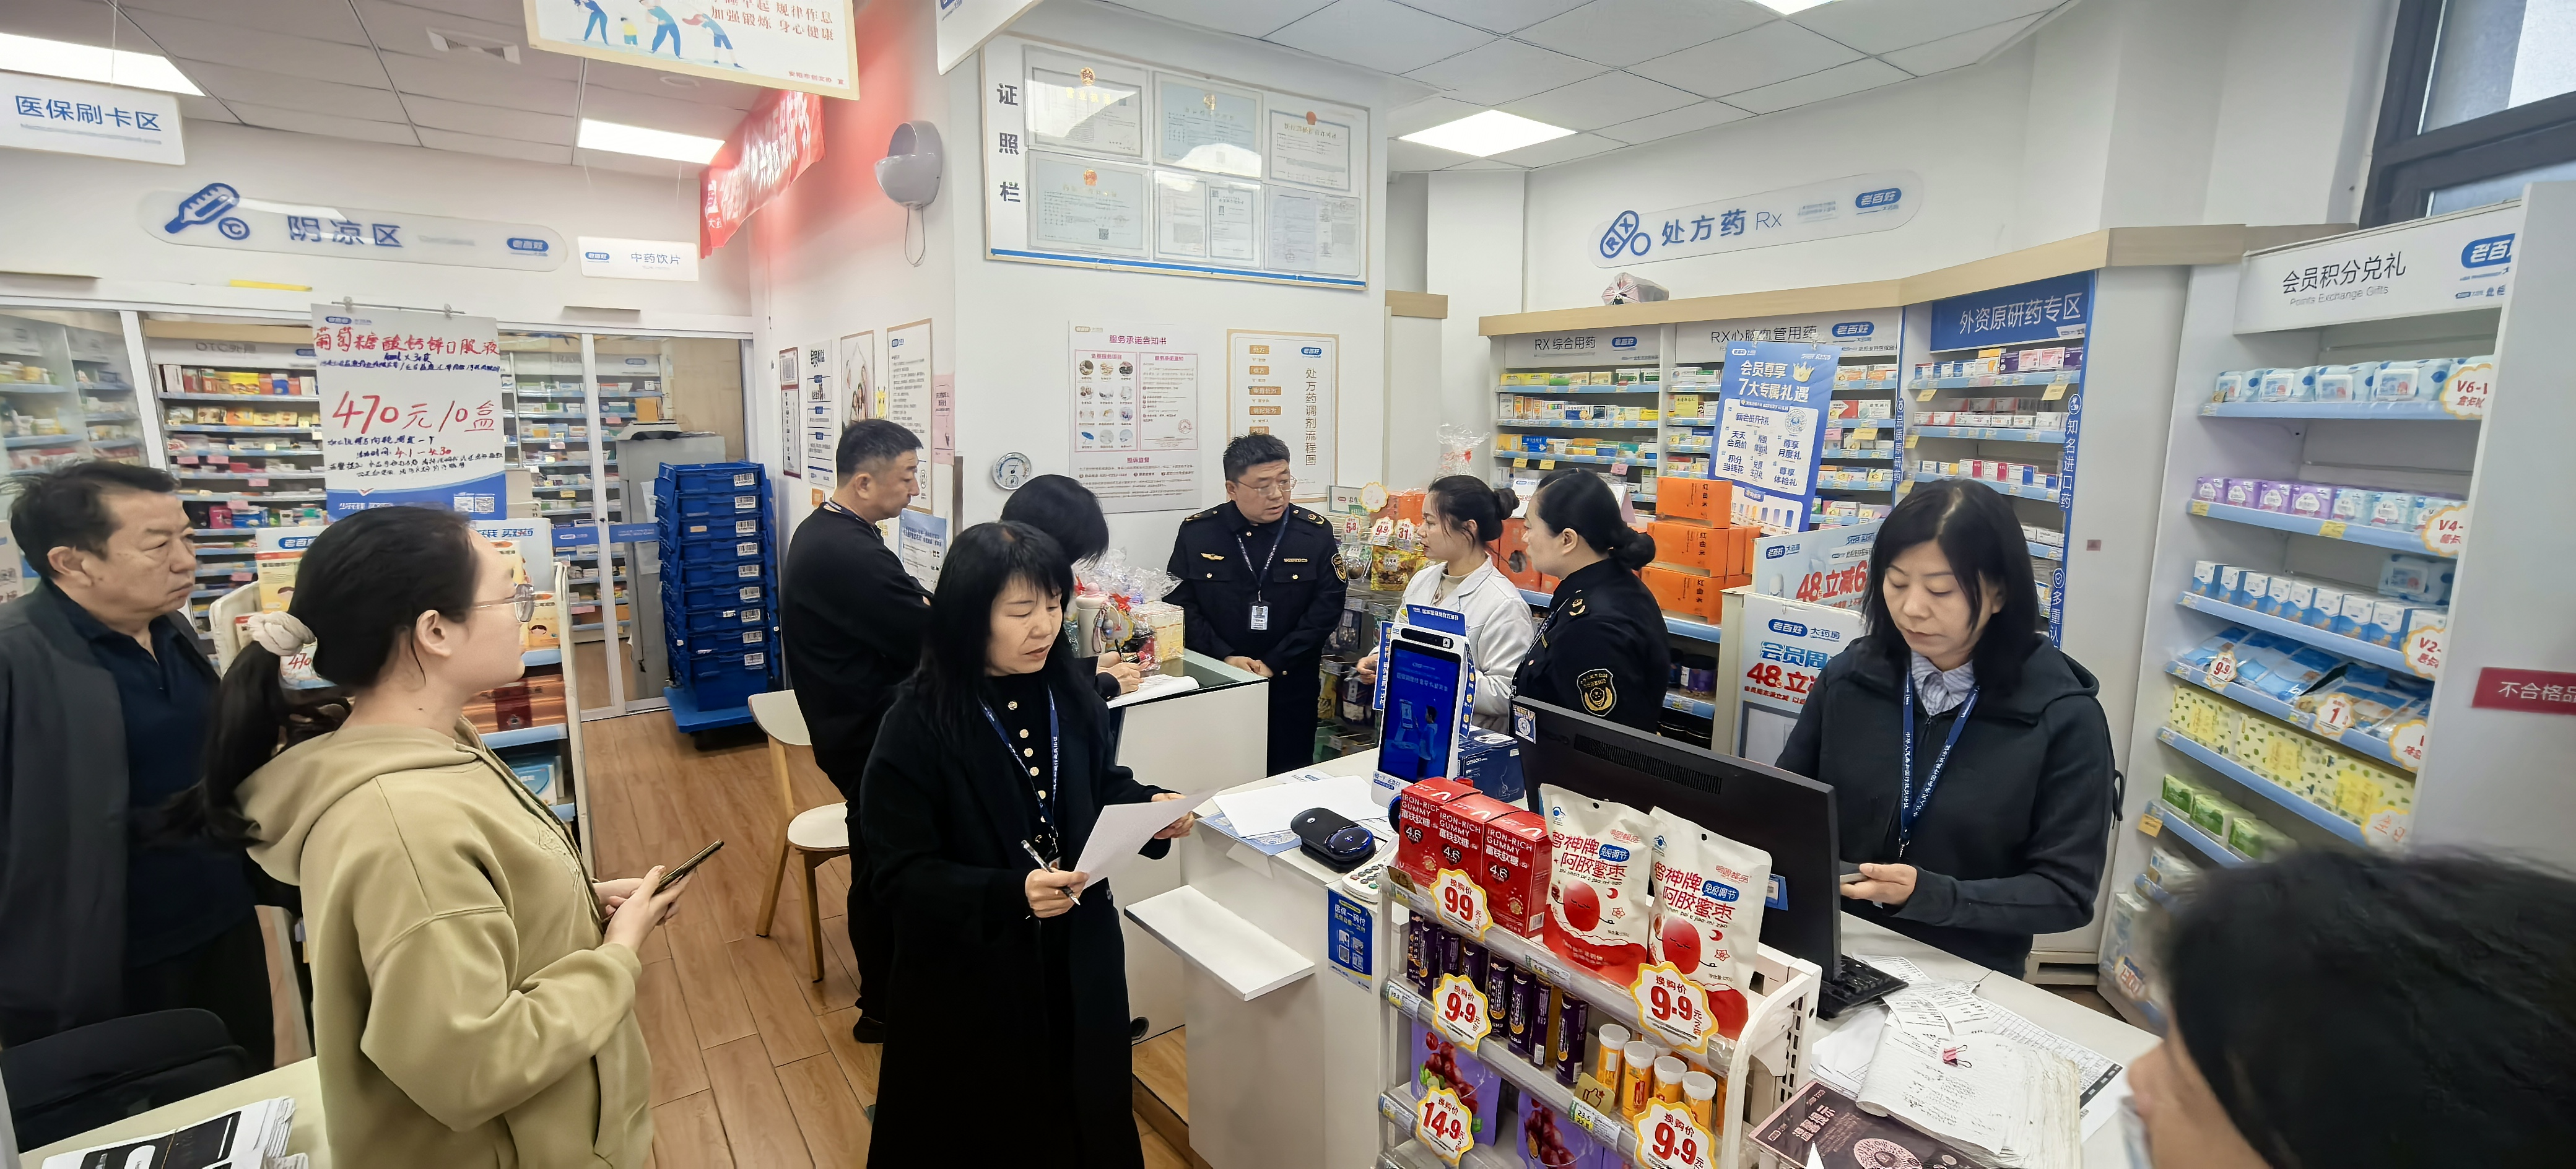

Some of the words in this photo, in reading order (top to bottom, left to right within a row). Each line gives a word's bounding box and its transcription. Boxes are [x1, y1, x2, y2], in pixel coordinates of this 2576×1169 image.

[711, 6, 772, 29] 加强锻炼
[780, 19, 833, 41] 身心健康
[777, 2, 833, 24] 规律作息
[15, 95, 162, 131] 医保刷卡区
[997, 83, 1021, 204] 证照栏
[287, 215, 404, 248] 阴凉区
[1661, 208, 1747, 246] 处方药
[1756, 211, 1782, 230] Rx
[631, 252, 681, 265] 中药饮片
[2470, 239, 2512, 263] 老百
[2282, 251, 2406, 294] 会员积分兑礼
[2318, 290, 2364, 303] Exchange
[1959, 292, 2082, 335] 外资原研药专区
[314, 326, 500, 355] 葡萄糖酸钙锌口服液
[1109, 335, 1167, 345] 服务承诺告知书
[1534, 339, 1550, 350] RX
[1552, 336, 1596, 350] 综合用药
[1741, 360, 1788, 379] 会员尊享
[1738, 378, 1810, 402] 7大专属礼遇
[1305, 367, 1317, 465] 处方药调剂流程图
[1726, 439, 1747, 449] 会员价
[1731, 430, 1746, 440] 天天
[2060, 419, 2079, 509] 知名进口药
[2050, 590, 2062, 648] 多重认
[1773, 622, 1804, 635] 老百姓
[1810, 628, 1840, 640] 大药房
[1760, 641, 1832, 670] 会员周
[2498, 681, 2576, 703] 不合格品
[1401, 801, 1431, 816] GUMMY
[1439, 820, 1470, 837] GUMMY
[1440, 812, 1481, 834] IRON-RICH
[1438, 828, 1470, 849] 富铁软糖
[1487, 827, 1533, 852] IRON-RICH
[1487, 836, 1520, 855] GUMMY
[1486, 845, 1519, 867] 富铁软糖
[1601, 846, 1629, 860] 免疫调节
[1489, 864, 1508, 878] 4.6
[1561, 852, 1628, 881] 阿胶蜜枣
[1655, 861, 1703, 892] 智神牌
[1450, 879, 1473, 896] 换购价
[1704, 882, 1736, 900] 免疫调节
[1445, 887, 1474, 922] 99
[1663, 886, 1736, 924] 阿胶蜜枣
[1454, 984, 1475, 1002] 换购价
[1656, 975, 1687, 994] 换购价
[1445, 993, 1476, 1023] 9.9
[1651, 986, 1693, 1021] 9.9
[1438, 1097, 1459, 1116] 换购价
[1577, 1110, 1591, 1122] 23.5
[1423, 1102, 1461, 1140] 14.9
[1664, 1113, 1695, 1138] 换购价
[1652, 1122, 1697, 1165] 9.9
